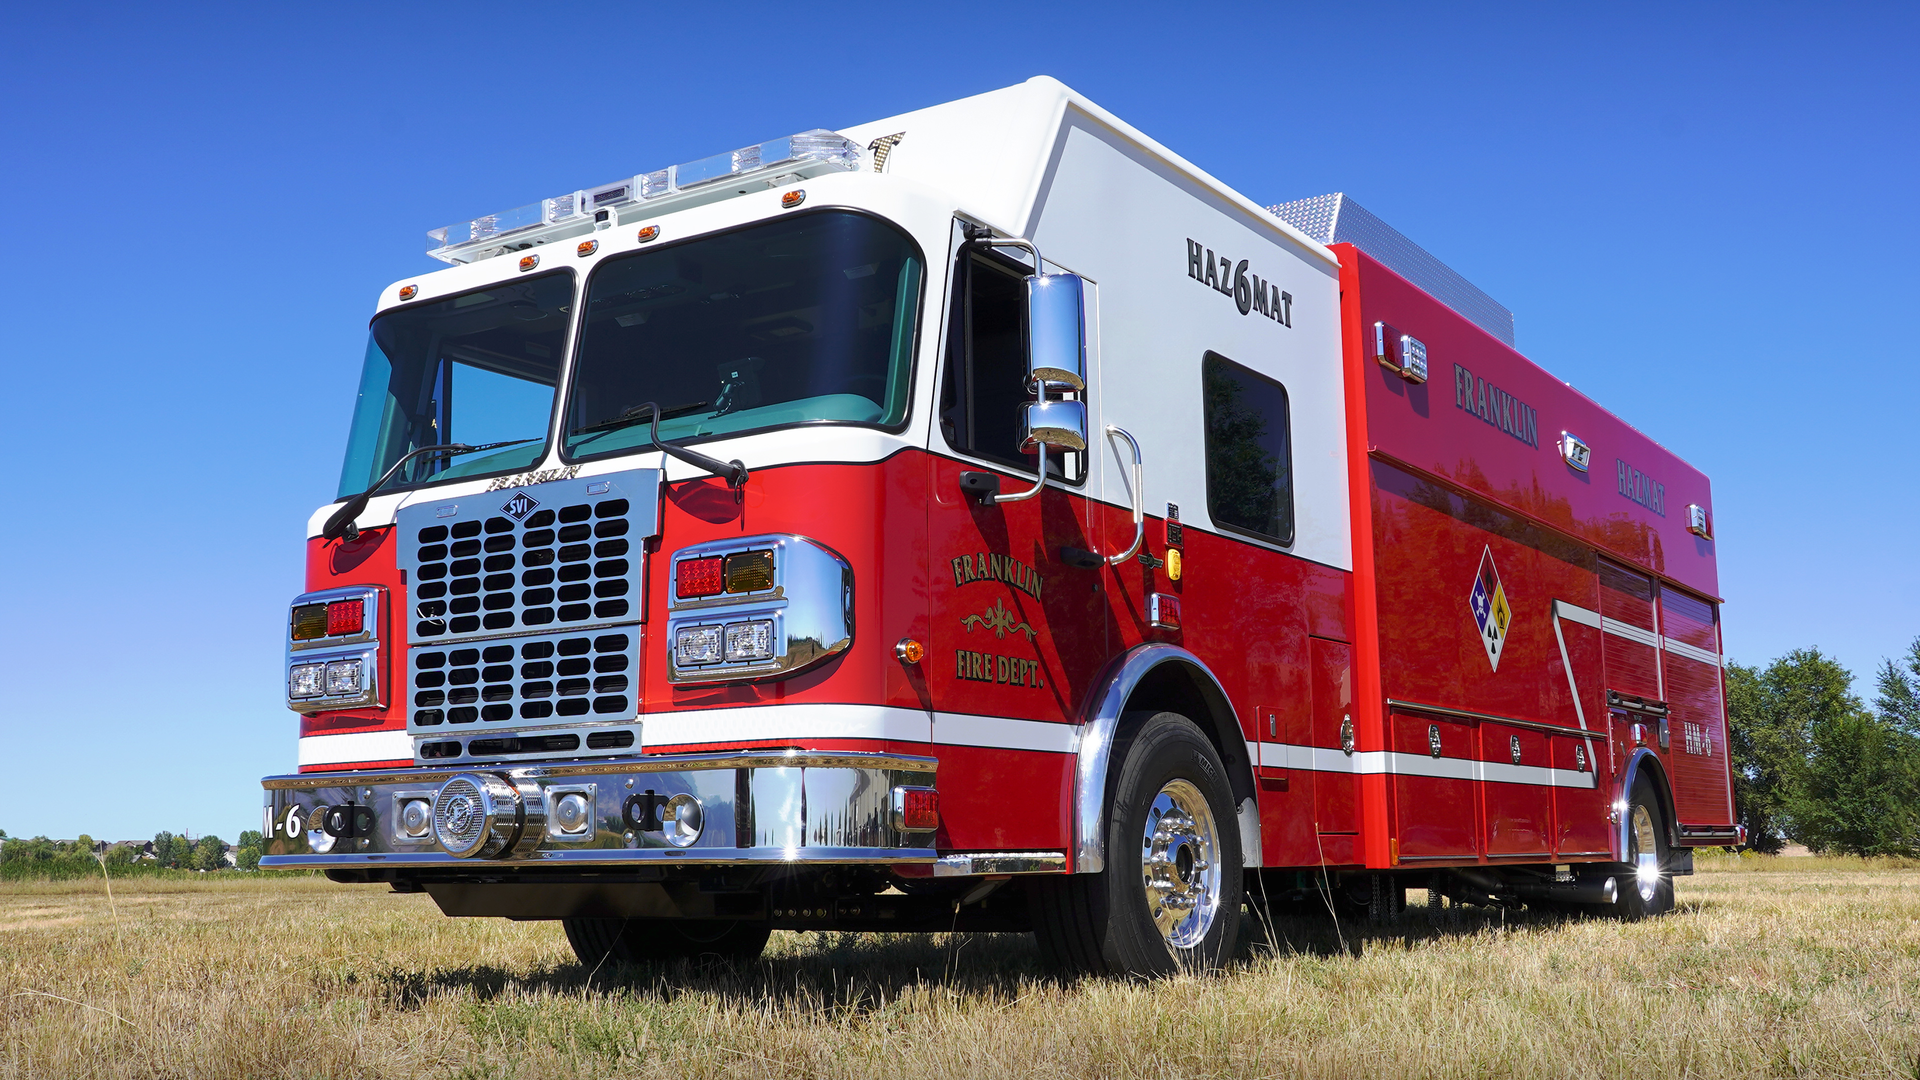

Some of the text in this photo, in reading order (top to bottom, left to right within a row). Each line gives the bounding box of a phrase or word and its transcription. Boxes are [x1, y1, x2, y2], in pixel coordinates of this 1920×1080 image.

[1453, 362, 1666, 518] FRANKLIN HAZMAT
[509, 498, 528, 515] SVI
[950, 552, 1044, 603] FRANKLIN
[955, 649, 1044, 689] FIRE DEPT.
[1683, 721, 1712, 757] HM-6
